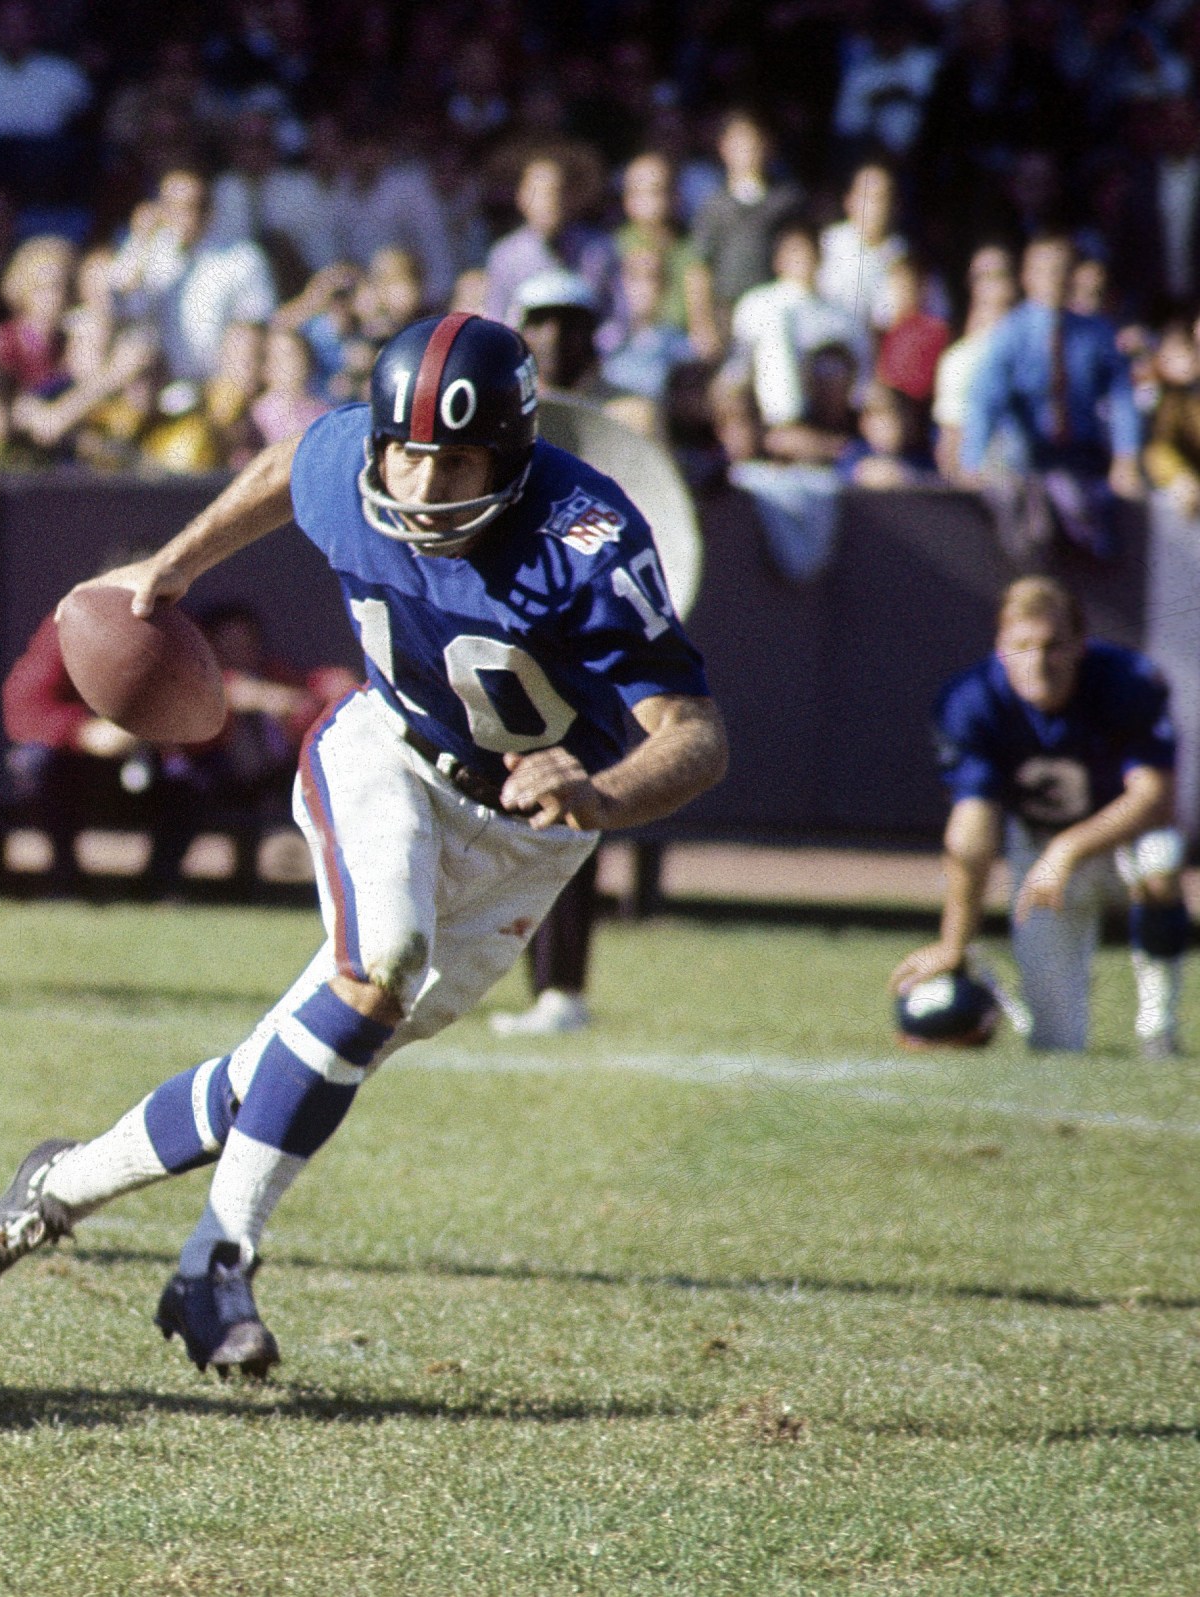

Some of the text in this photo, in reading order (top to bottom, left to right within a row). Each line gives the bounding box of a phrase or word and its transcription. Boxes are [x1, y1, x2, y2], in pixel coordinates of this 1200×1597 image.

[393, 370, 477, 430] 10
[350, 598, 578, 754] 10
[1014, 756, 1089, 821] 3
